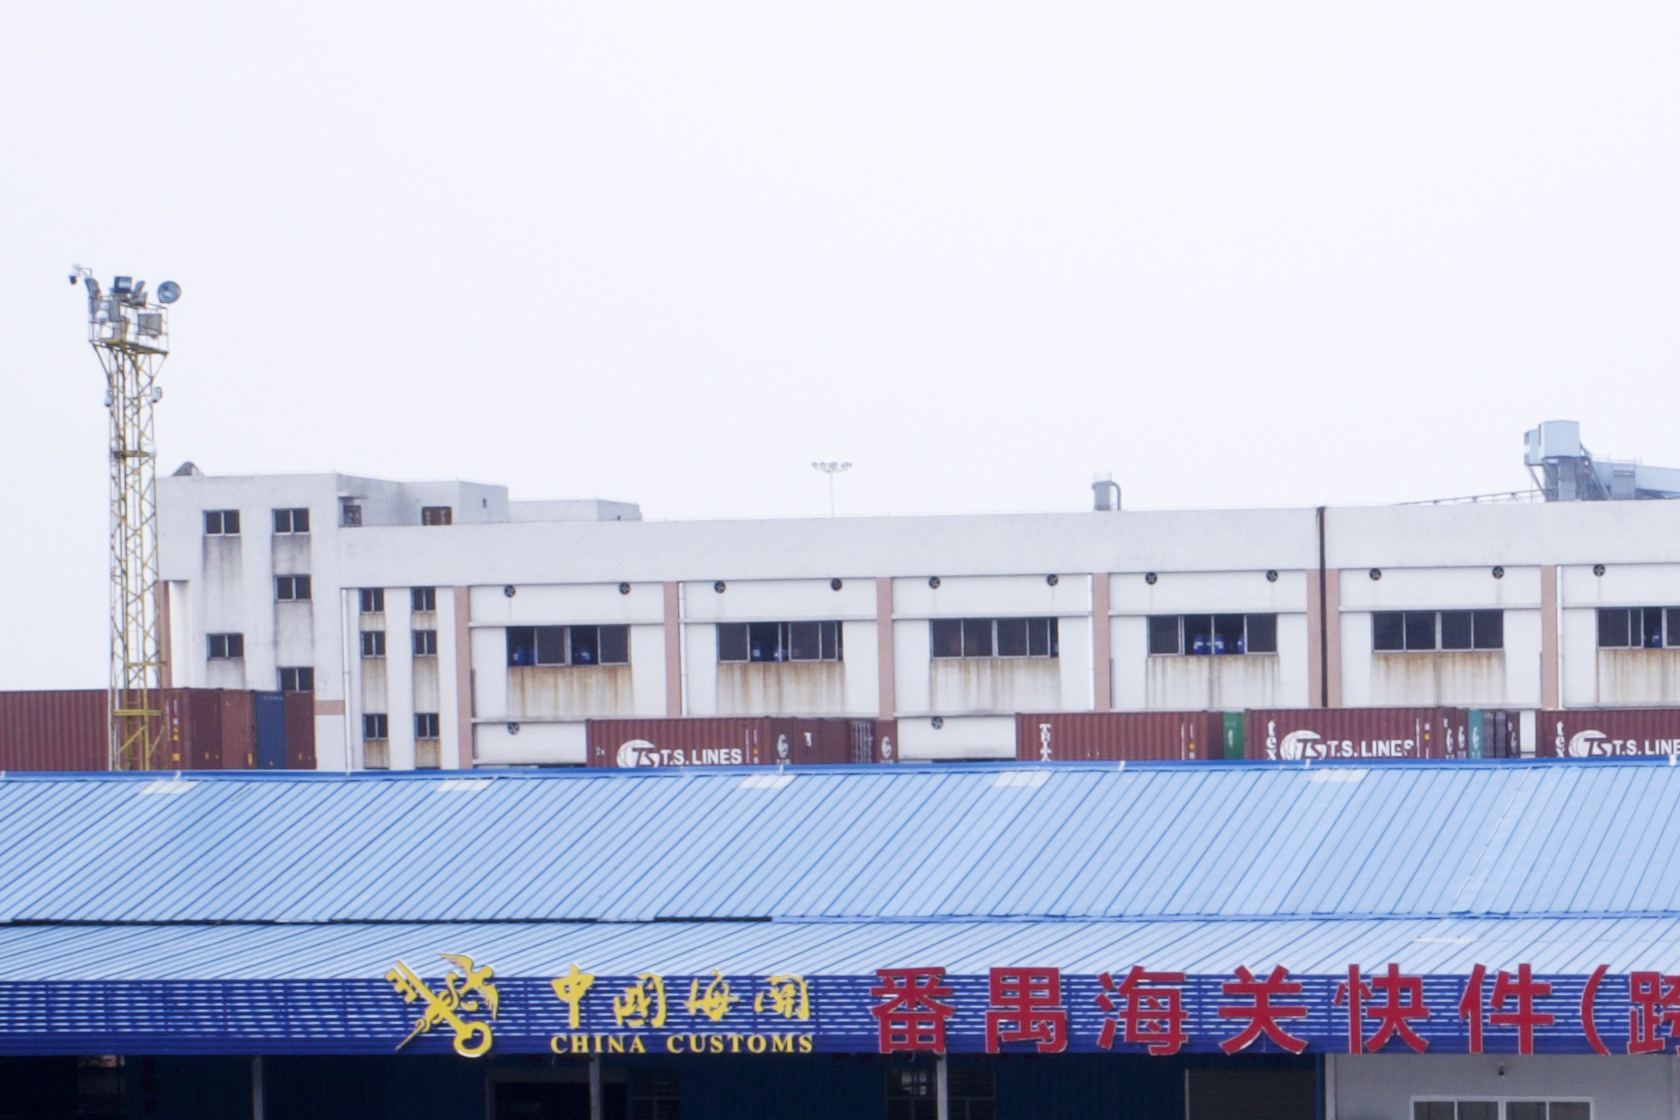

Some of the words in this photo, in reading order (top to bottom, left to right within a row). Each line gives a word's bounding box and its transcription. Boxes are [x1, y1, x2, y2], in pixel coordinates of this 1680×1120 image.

[1327, 740, 1358, 757] T.S.
[1613, 740, 1642, 755] T.S.
[660, 749, 689, 765] T.S.
[692, 748, 742, 764] LINES
[550, 1034, 647, 1054] CHINA
[666, 1034, 814, 1054] CUSTOMS
